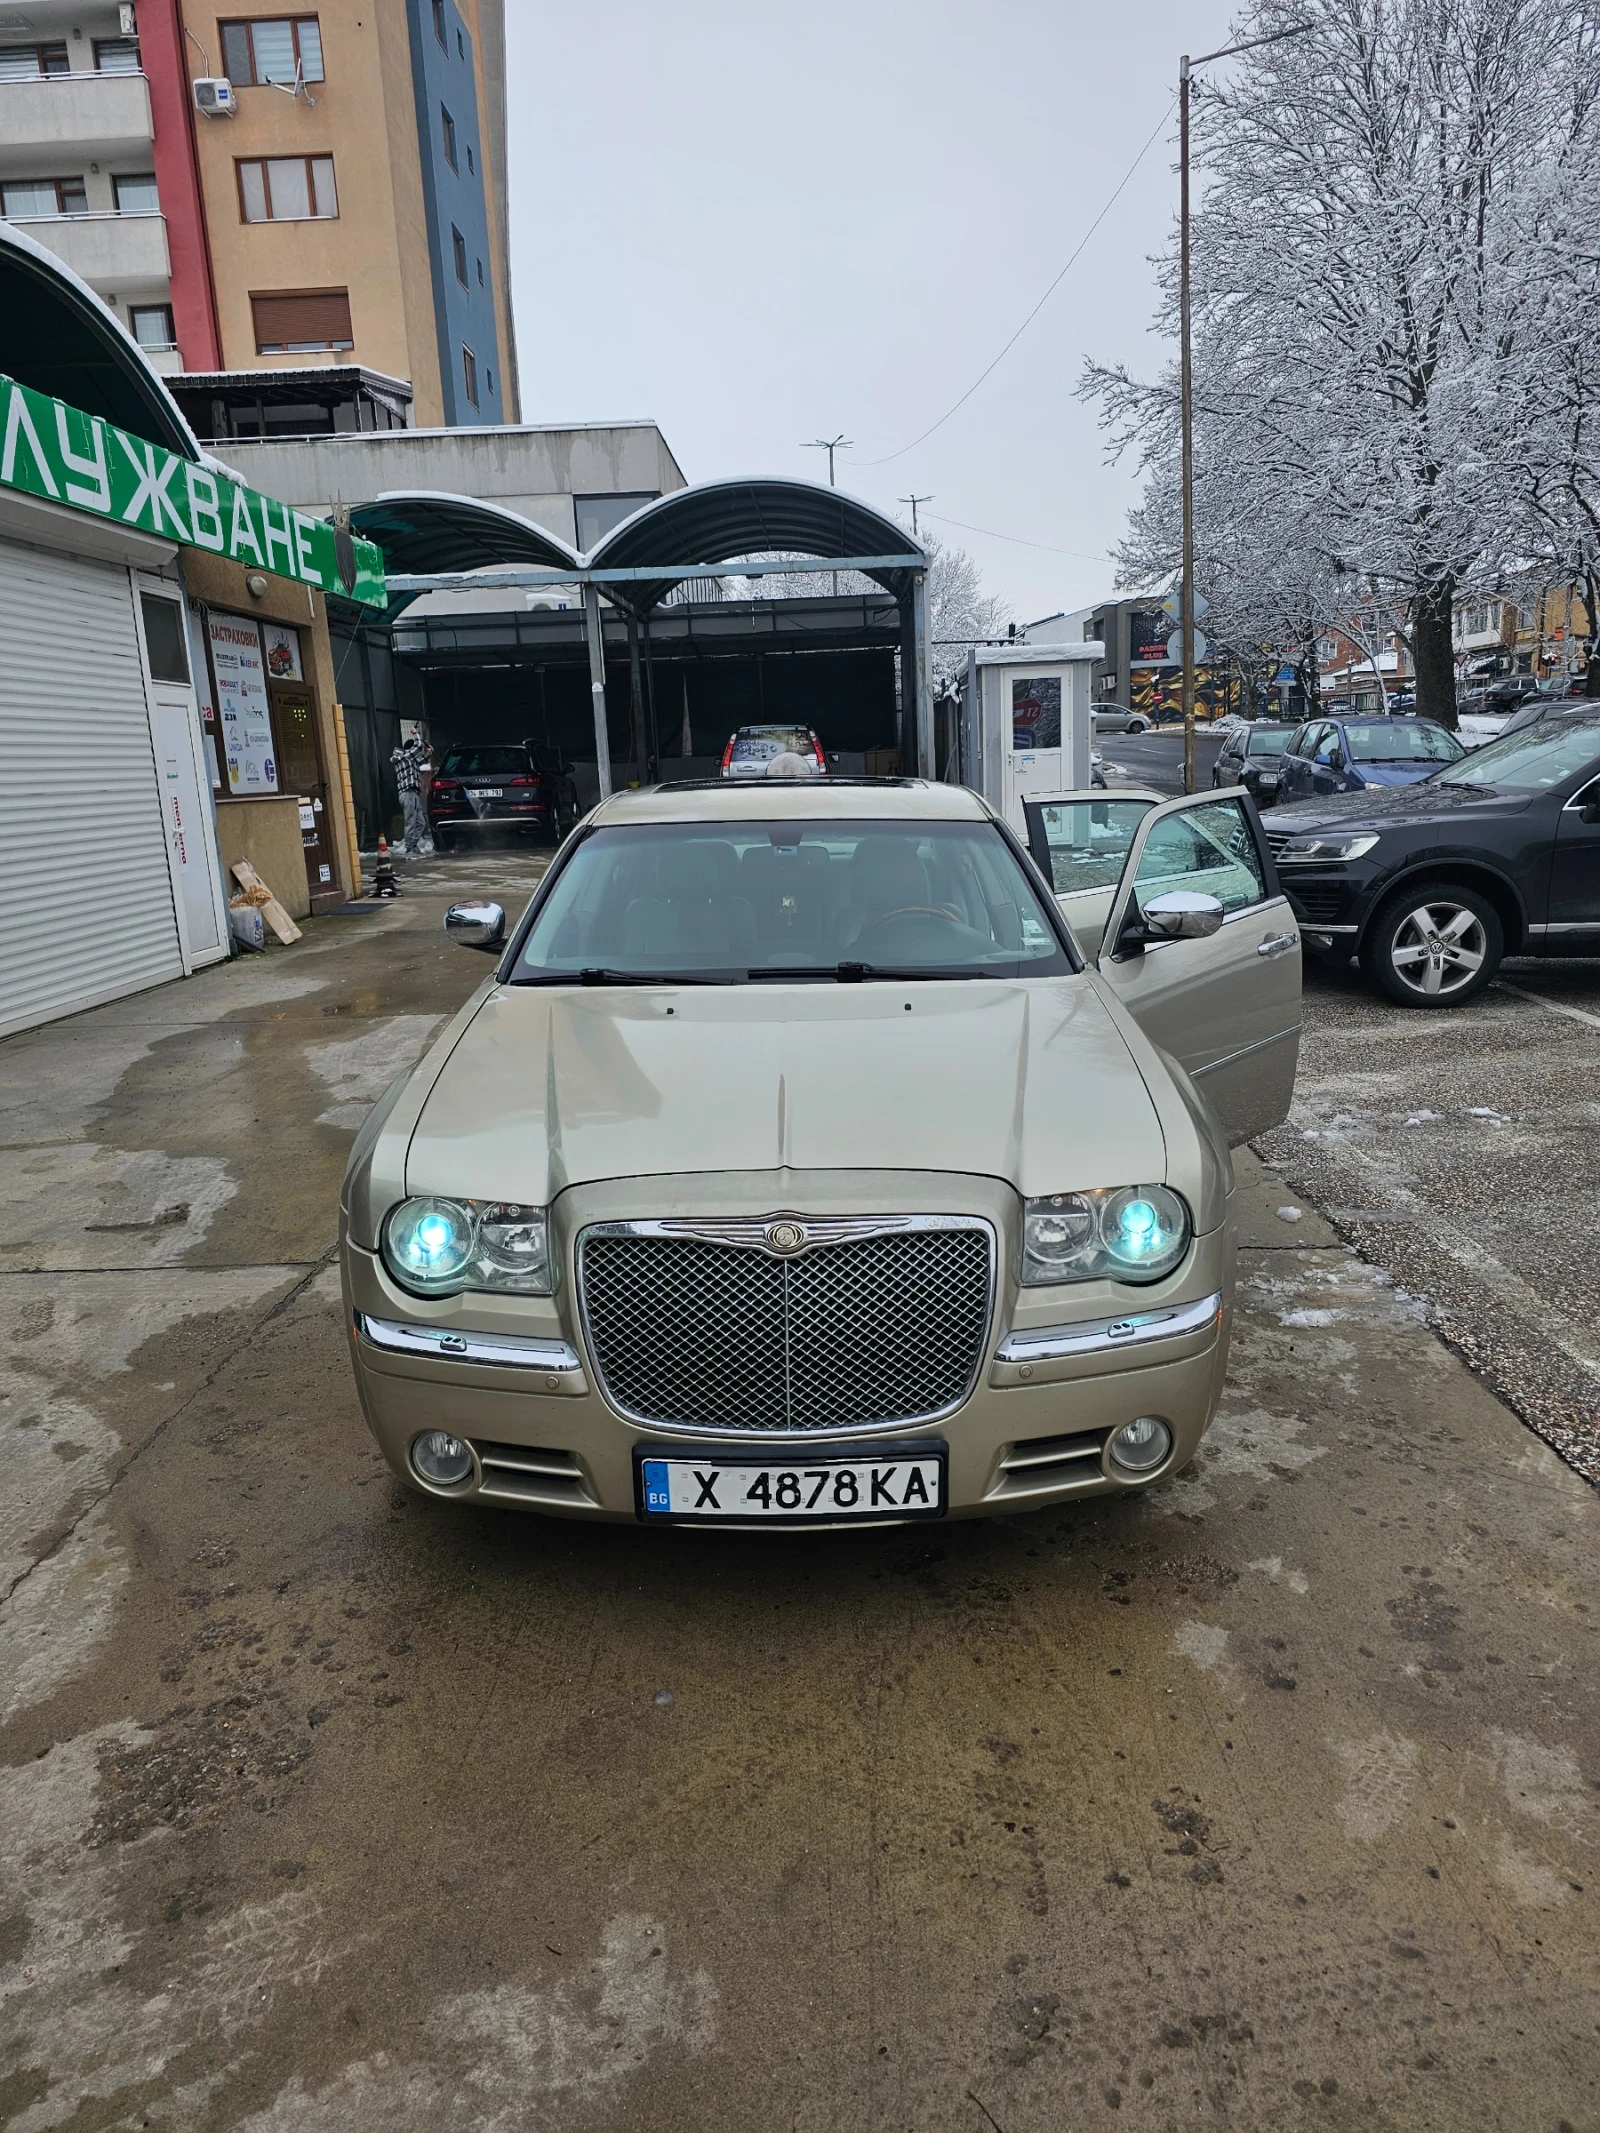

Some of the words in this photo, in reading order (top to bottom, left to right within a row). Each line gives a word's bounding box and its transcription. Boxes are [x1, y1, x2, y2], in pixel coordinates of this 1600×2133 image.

[1, 386, 323, 584] ЛУЖВАНЕ
[210, 624, 258, 648] ЗАСТРАХОВКИ
[173, 797, 187, 865] menerna
[649, 1492, 668, 1504] BG
[746, 1469, 859, 1509] 4878
[871, 1466, 930, 1507] KA
